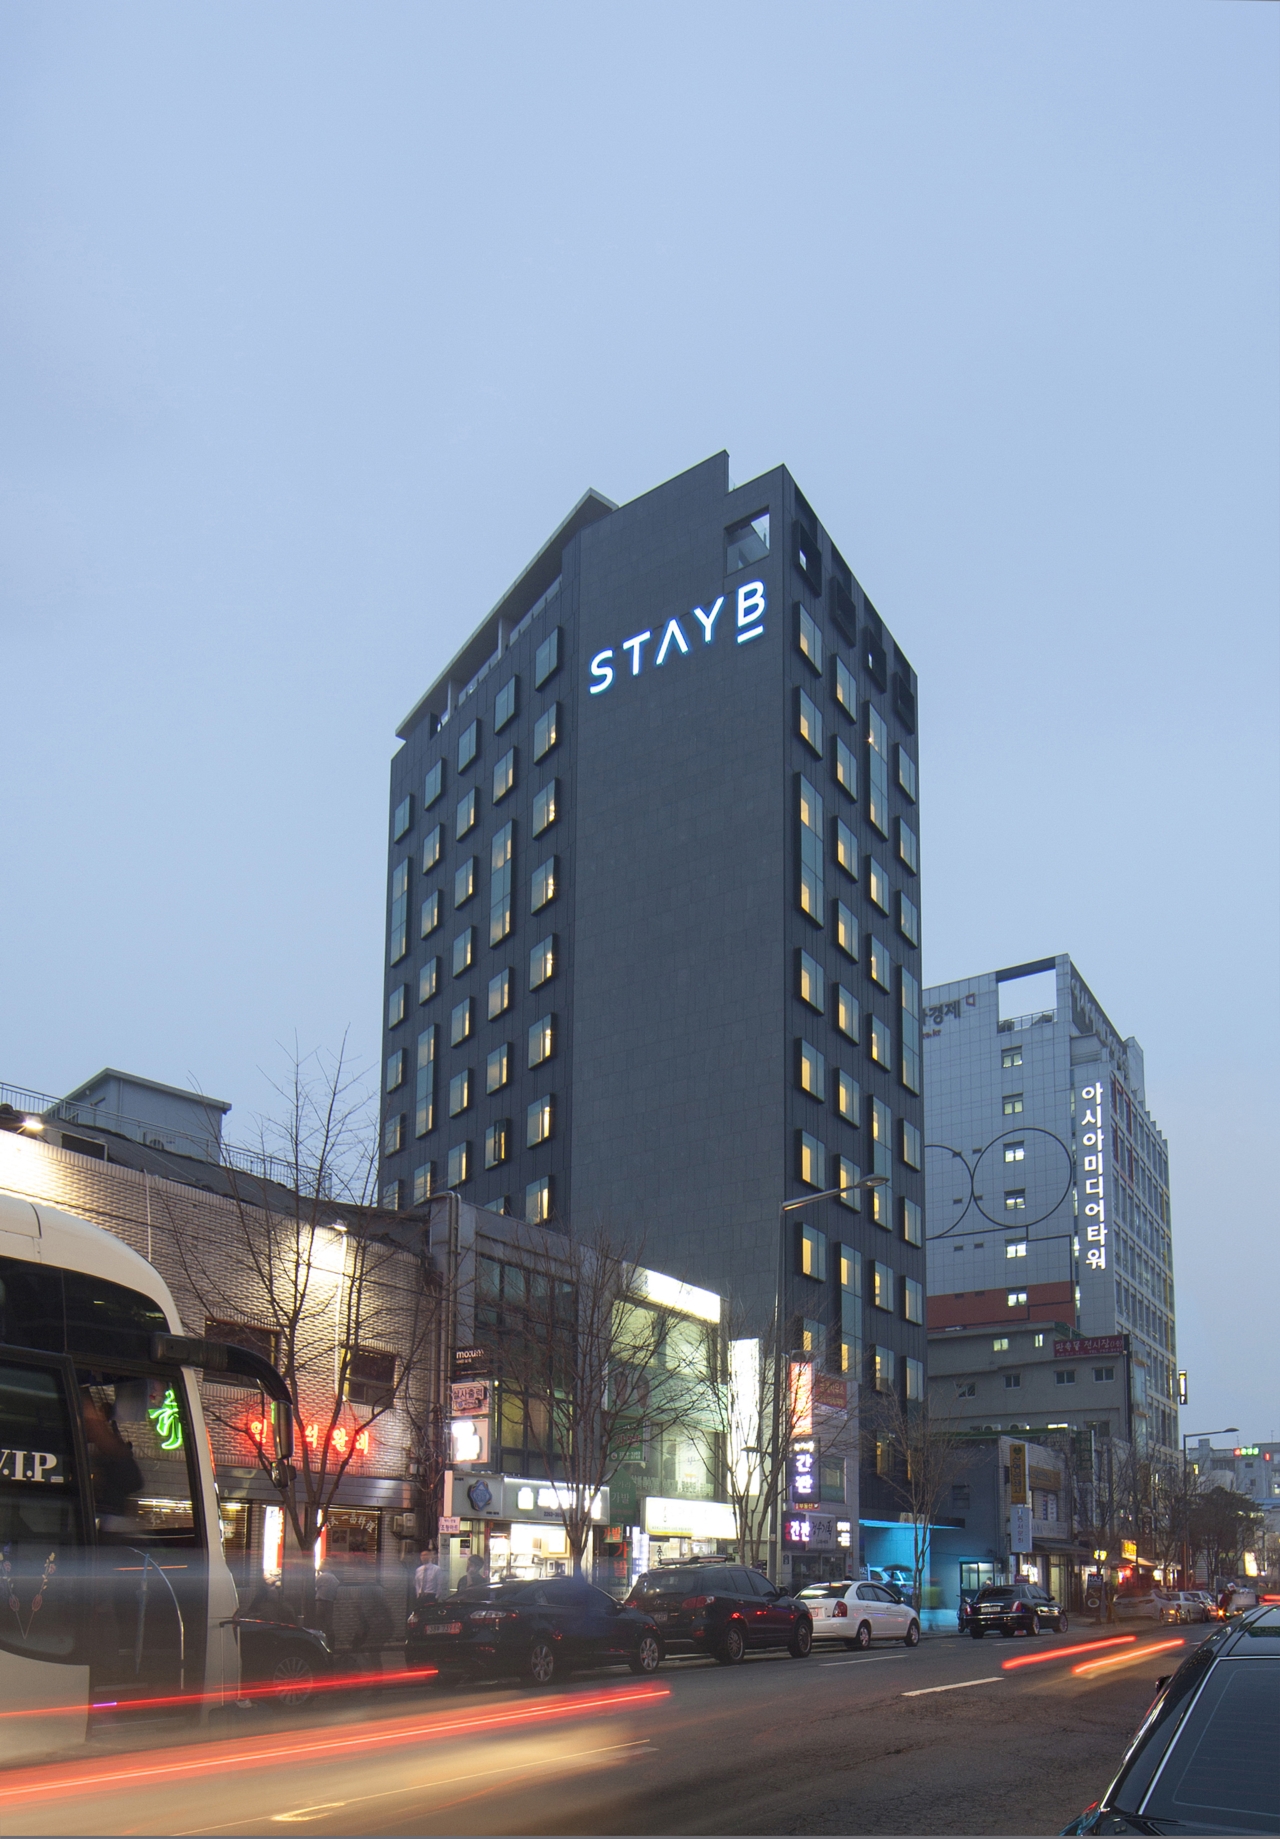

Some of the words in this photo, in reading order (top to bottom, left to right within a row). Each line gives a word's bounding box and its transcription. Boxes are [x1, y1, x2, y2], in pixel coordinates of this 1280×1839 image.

[1081, 1082, 1108, 1270] 아시아미디어타워
[453, 1387, 483, 1400] 실사출력
[795, 1453, 813, 1494] 간판
[603, 1527, 621, 1541] 가발
[790, 1521, 810, 1541] 간판
[614, 1542, 629, 1577] 가발
